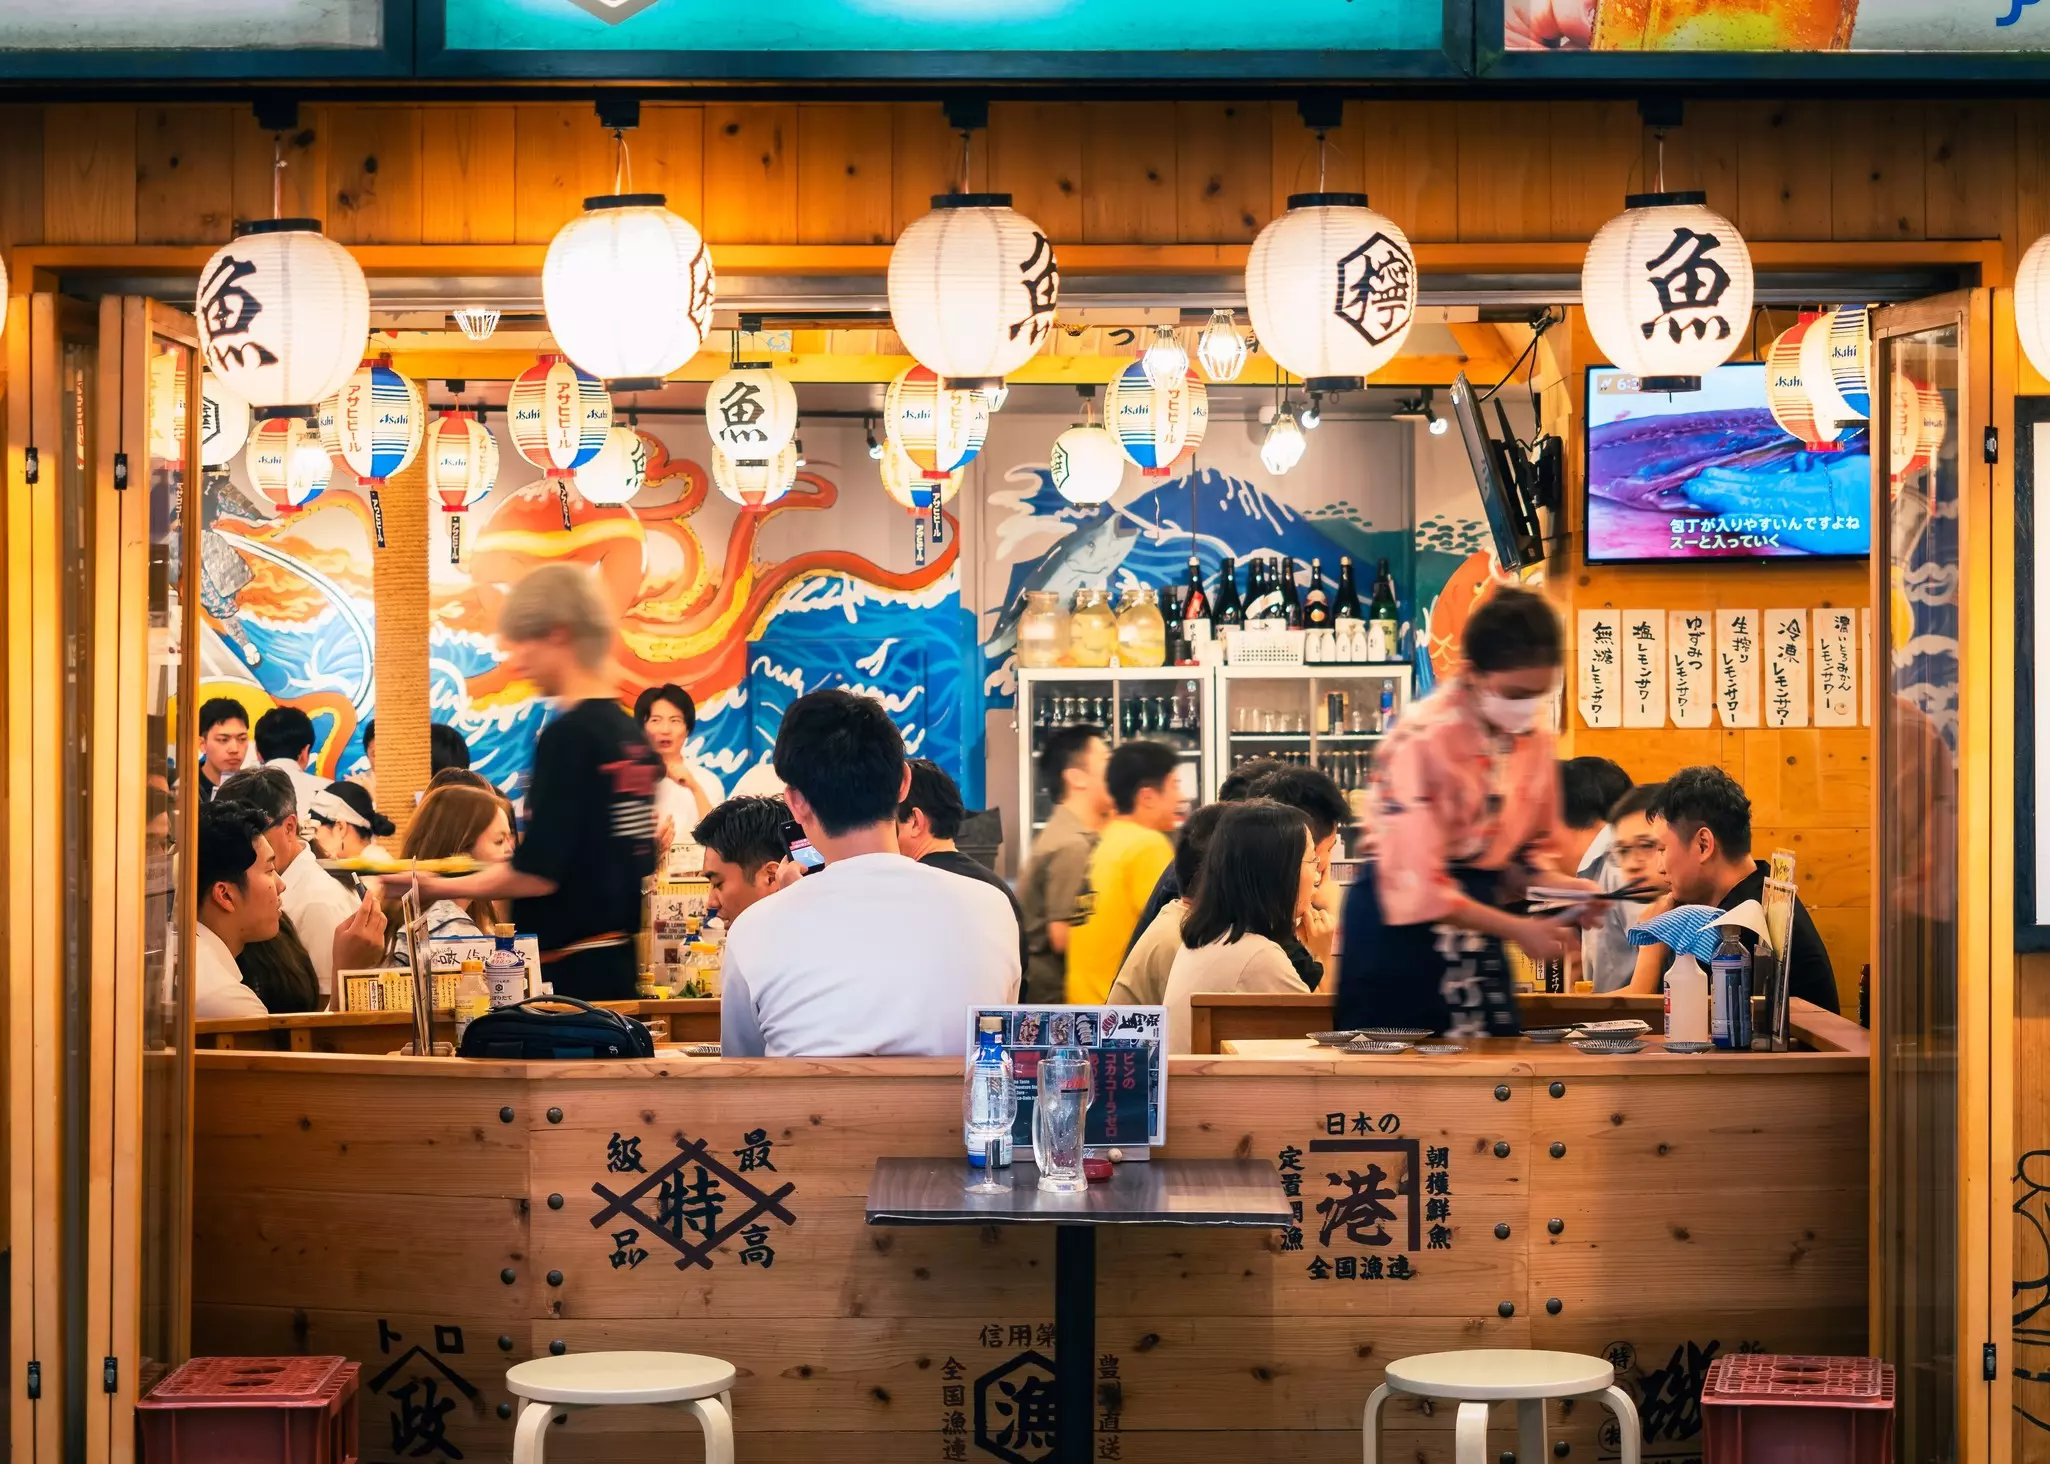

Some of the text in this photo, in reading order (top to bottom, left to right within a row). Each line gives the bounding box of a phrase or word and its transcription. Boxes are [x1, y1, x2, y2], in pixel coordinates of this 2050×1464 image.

[1641, 227, 1731, 344] 魚
[200, 255, 279, 372] 魚
[1617, 377, 1640, 391] 6:3
[346, 385, 362, 453] アサヒビール
[379, 413, 409, 425] Asahi
[515, 409, 541, 420] Asahi
[556, 382, 571, 449] アサヒビール
[586, 408, 608, 419] Asahi
[719, 382, 768, 443] 魚
[901, 410, 931, 420] Asahi
[1120, 404, 1149, 415] Asahi
[1164, 388, 1180, 444] サヒビール
[1670, 516, 1860, 533] 包丁が入りやすいんですよね
[1670, 535, 1780, 549] スーと入っていく
[1674, 654, 1690, 717] レモンサワー
[1722, 653, 1739, 722] レモンサワー
[1821, 638, 1835, 708] レモンサワー
[1122, 1052, 1136, 1089] ビンの
[1326, 1111, 1400, 1136] 日本の
[607, 1132, 648, 1173] 級
[733, 1128, 777, 1172] 最
[656, 1165, 727, 1241] 特
[1316, 1163, 1398, 1248] 港
[1425, 1145, 1452, 1250] 朝獲鮮魚
[608, 1228, 649, 1269] 品
[739, 1223, 776, 1269] 高
[1306, 1255, 1416, 1281] 全国漁連
[1098, 1354, 1123, 1461] 豊直送
